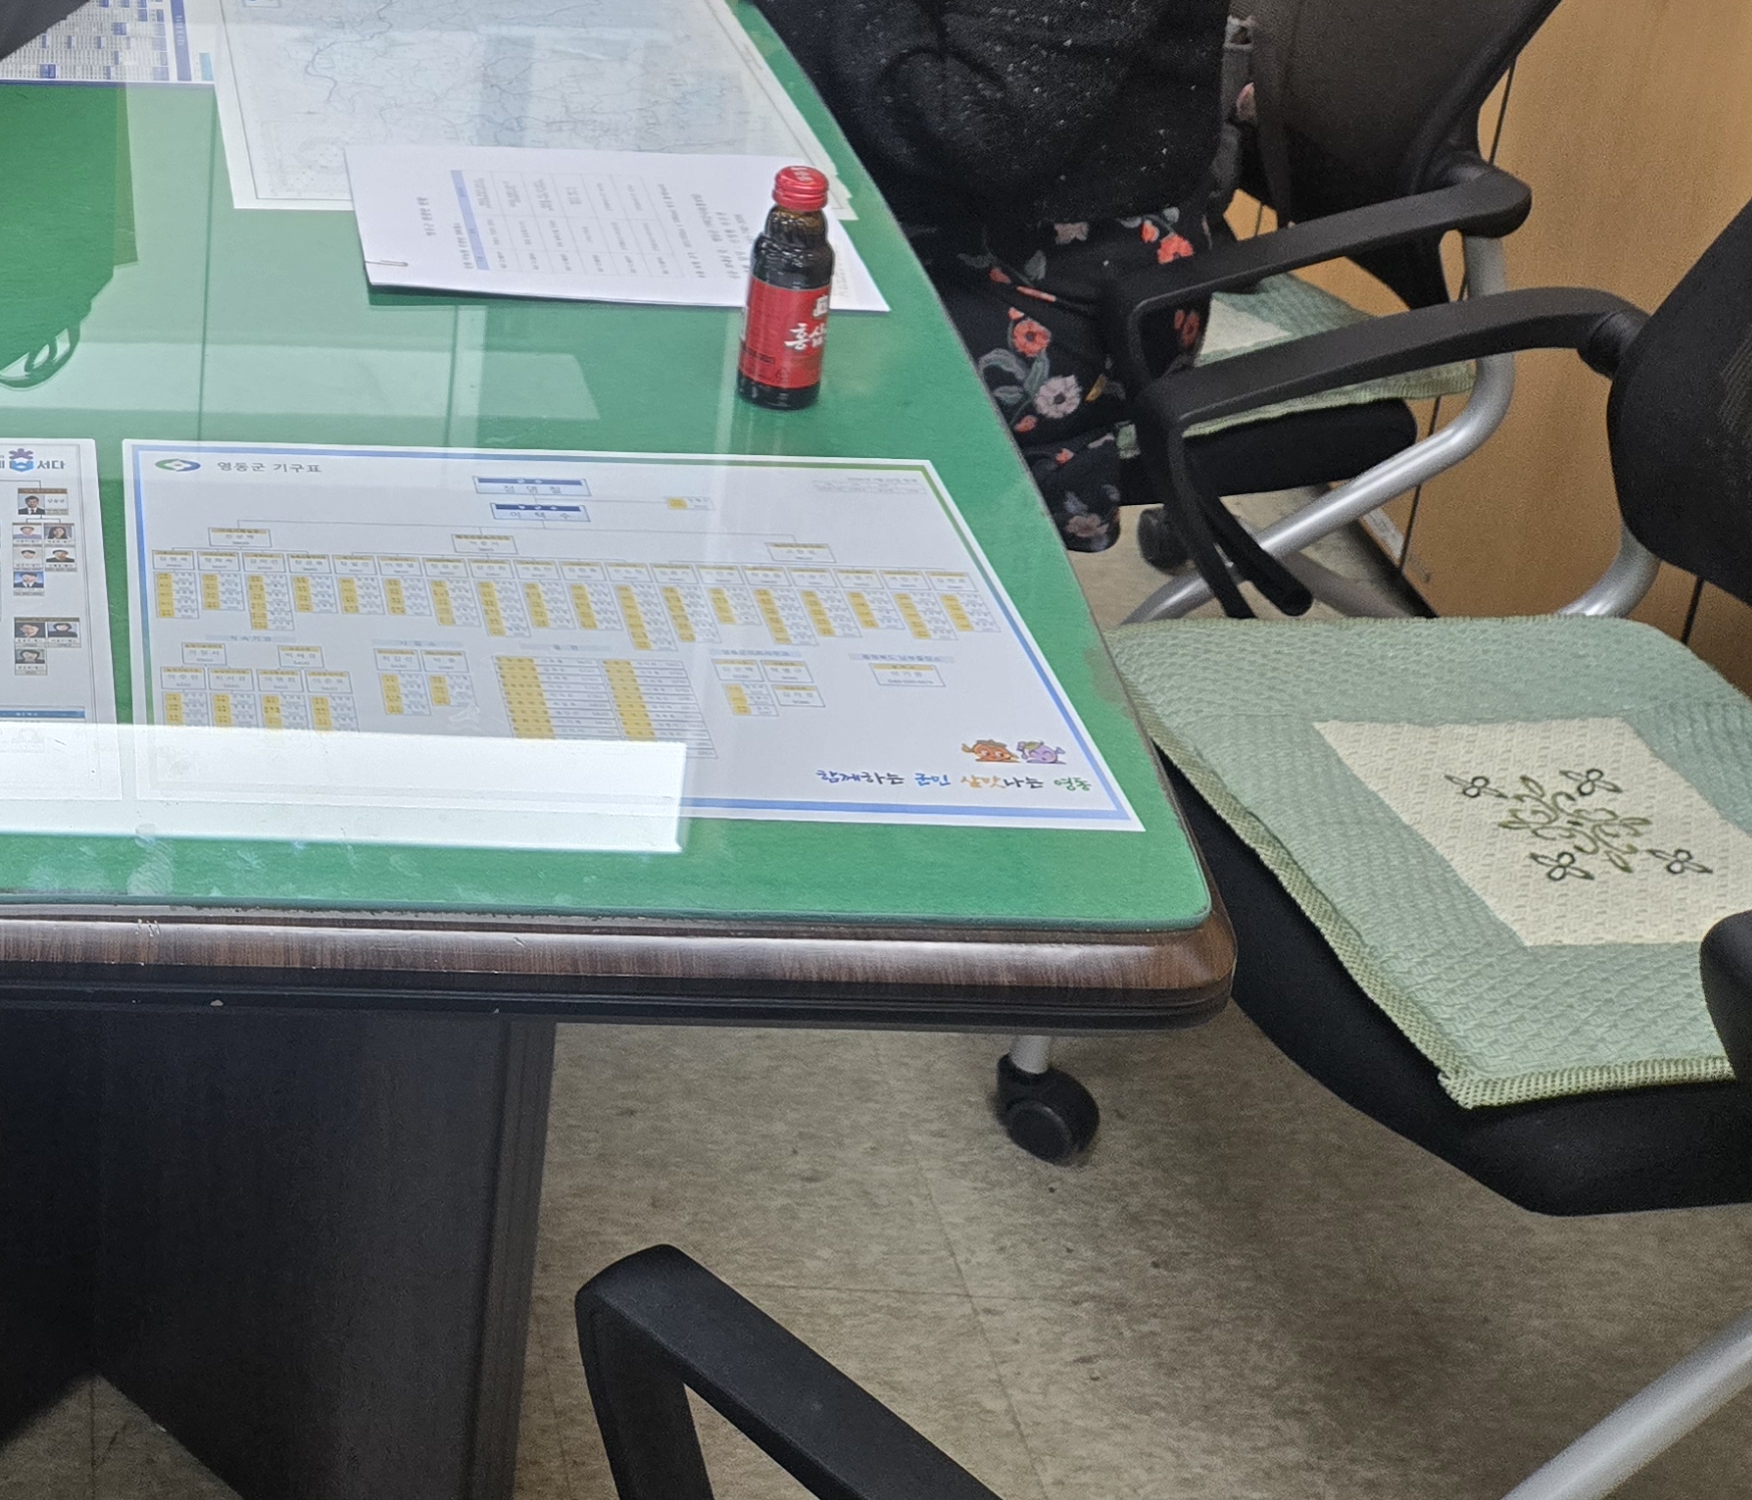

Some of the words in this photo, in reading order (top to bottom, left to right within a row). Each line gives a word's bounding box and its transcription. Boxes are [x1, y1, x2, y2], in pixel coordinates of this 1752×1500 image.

[37, 460, 66, 469] 서다
[217, 461, 266, 472] 영동군
[273, 463, 322, 473] 기구표
[816, 769, 905, 784] 함께하는
[914, 772, 952, 787] 군민
[960, 775, 1044, 790] 살맛나는
[1054, 778, 1092, 792] 영동
